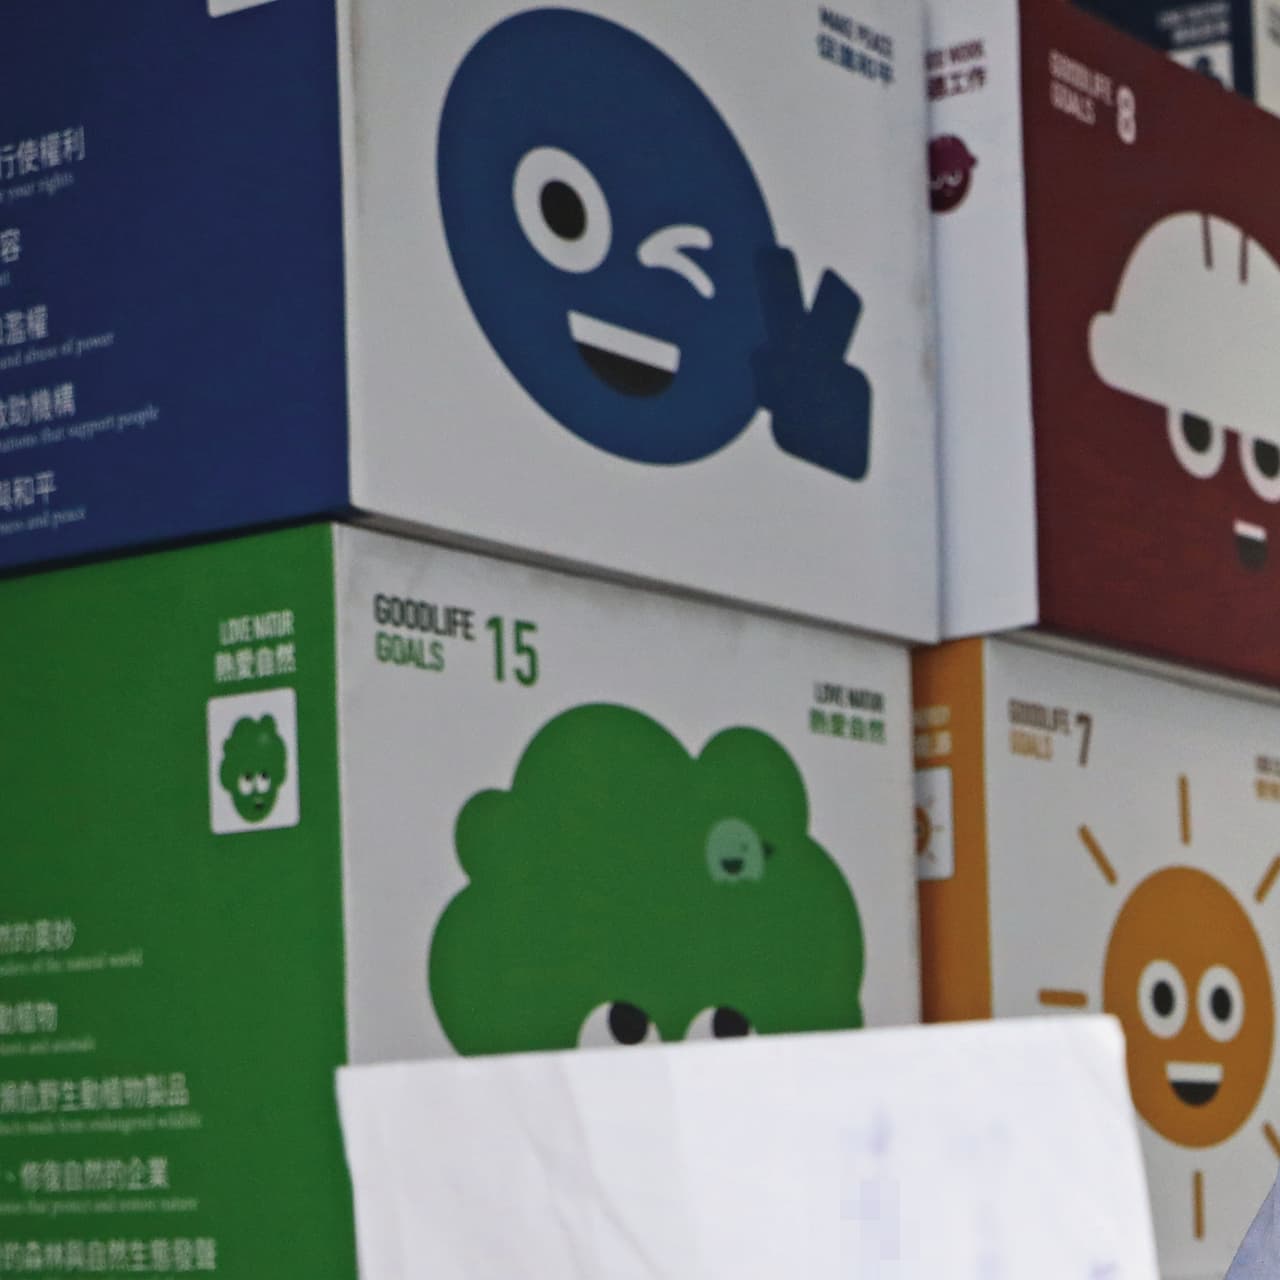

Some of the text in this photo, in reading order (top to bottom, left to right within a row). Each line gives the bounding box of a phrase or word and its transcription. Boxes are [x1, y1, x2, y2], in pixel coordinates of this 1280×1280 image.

[1116, 86, 1136, 144] 8
[373, 593, 539, 687] GOODLIFE 15
[375, 631, 444, 672] GOALS
[1076, 711, 1093, 767] 7
